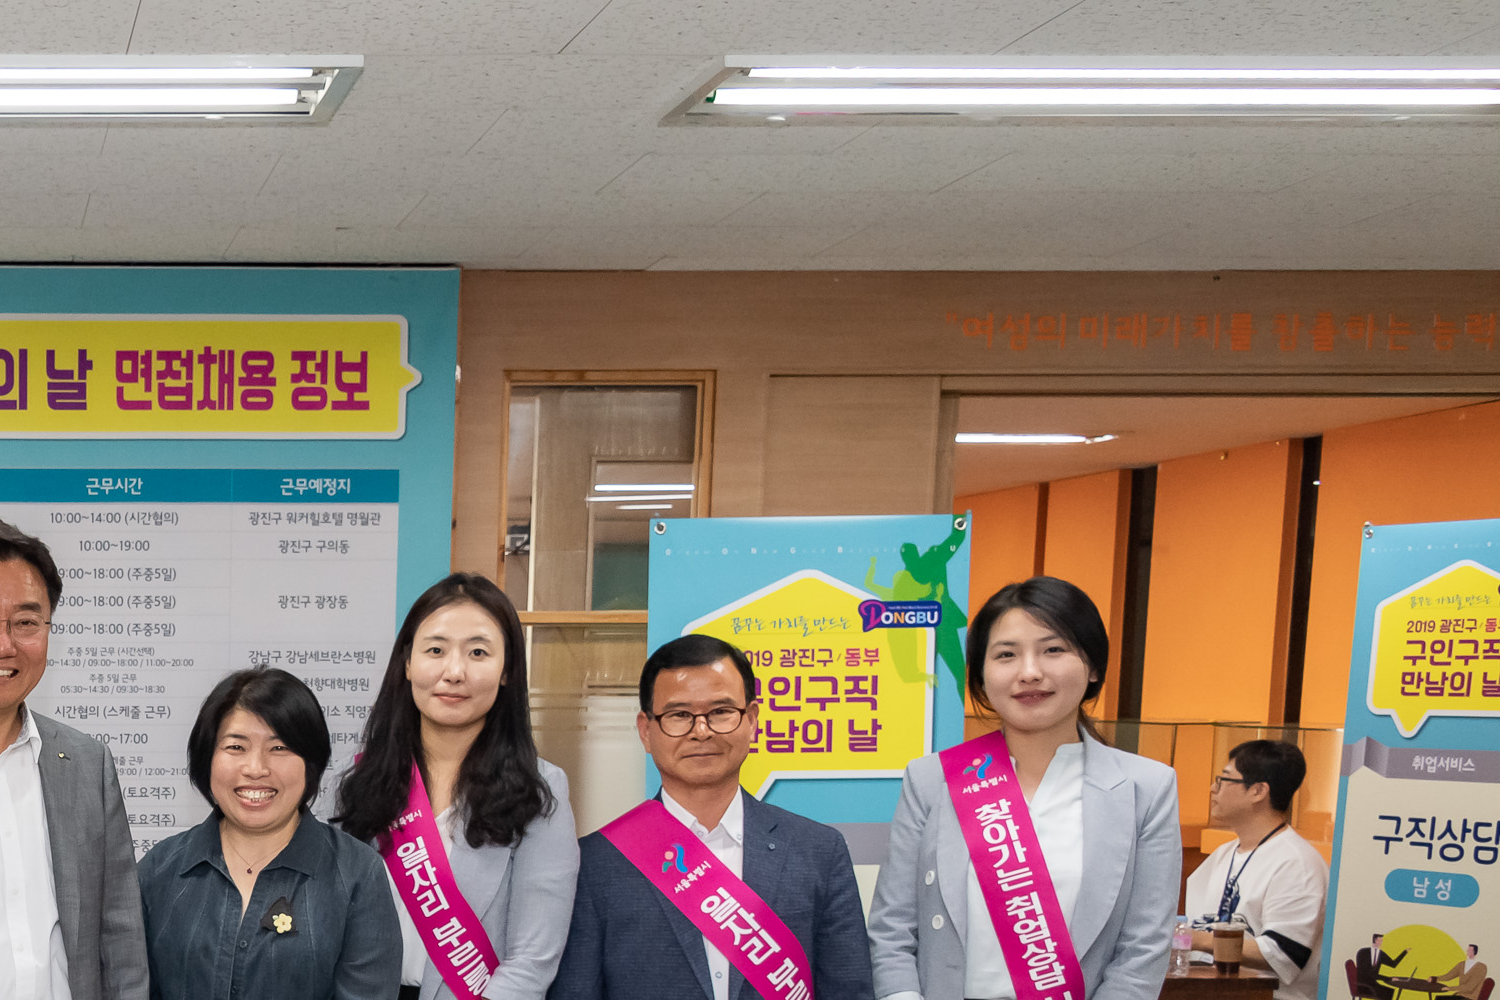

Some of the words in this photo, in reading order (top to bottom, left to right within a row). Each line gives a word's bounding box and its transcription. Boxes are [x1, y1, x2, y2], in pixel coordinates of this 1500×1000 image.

[45, 348, 93, 410] 날
[115, 345, 277, 411] 면접채용
[290, 350, 370, 411] 정보
[86, 477, 143, 496] 근무시간
[280, 477, 351, 496] 근무예정지
[50, 512, 121, 524] 10:00~14:00
[125, 511, 179, 526] (시간협의)
[248, 511, 283, 526] 광진구
[286, 511, 343, 526] 워커힐호텔
[346, 511, 381, 526] 명월관
[79, 540, 150, 551] 10:00~19:00
[278, 540, 313, 554] 광진구
[316, 539, 350, 554] 구의동
[58, 568, 124, 579] 9:00~18:00
[127, 567, 176, 582] (주중5일)
[58, 595, 124, 607] 9:00~18:00
[127, 595, 176, 609] (주중5일)
[278, 595, 312, 609] 광진구
[314, 595, 349, 609] 광장동
[731, 616, 767, 635] 꿈꾸는
[813, 616, 852, 631] 만드는
[860, 600, 939, 631] DONGBU
[51, 623, 123, 635] 09:00~18:00
[127, 623, 176, 637] (주중5일)
[1406, 620, 1436, 633] 2019
[100, 647, 115, 657] 근무
[248, 650, 283, 664] 강남구
[747, 650, 773, 667] 019
[122, 674, 138, 683] 근무
[1401, 671, 1473, 697] 만남의
[54, 706, 100, 719] 시간협의
[103, 706, 142, 719] (스케줄
[144, 706, 171, 719] 근무)
[848, 718, 882, 752] 날
[1412, 755, 1475, 773] 취업서비스
[962, 774, 1008, 794] 서울특별시
[123, 787, 176, 800] (토요격주)
[127, 813, 176, 827] 토요격주)
[1373, 815, 1500, 865] 구직상담
[396, 835, 449, 918] 일자리
[975, 798, 1034, 892] 찾아가는
[1005, 891, 1067, 991] 취업상담
[700, 886, 781, 966] 일자리
